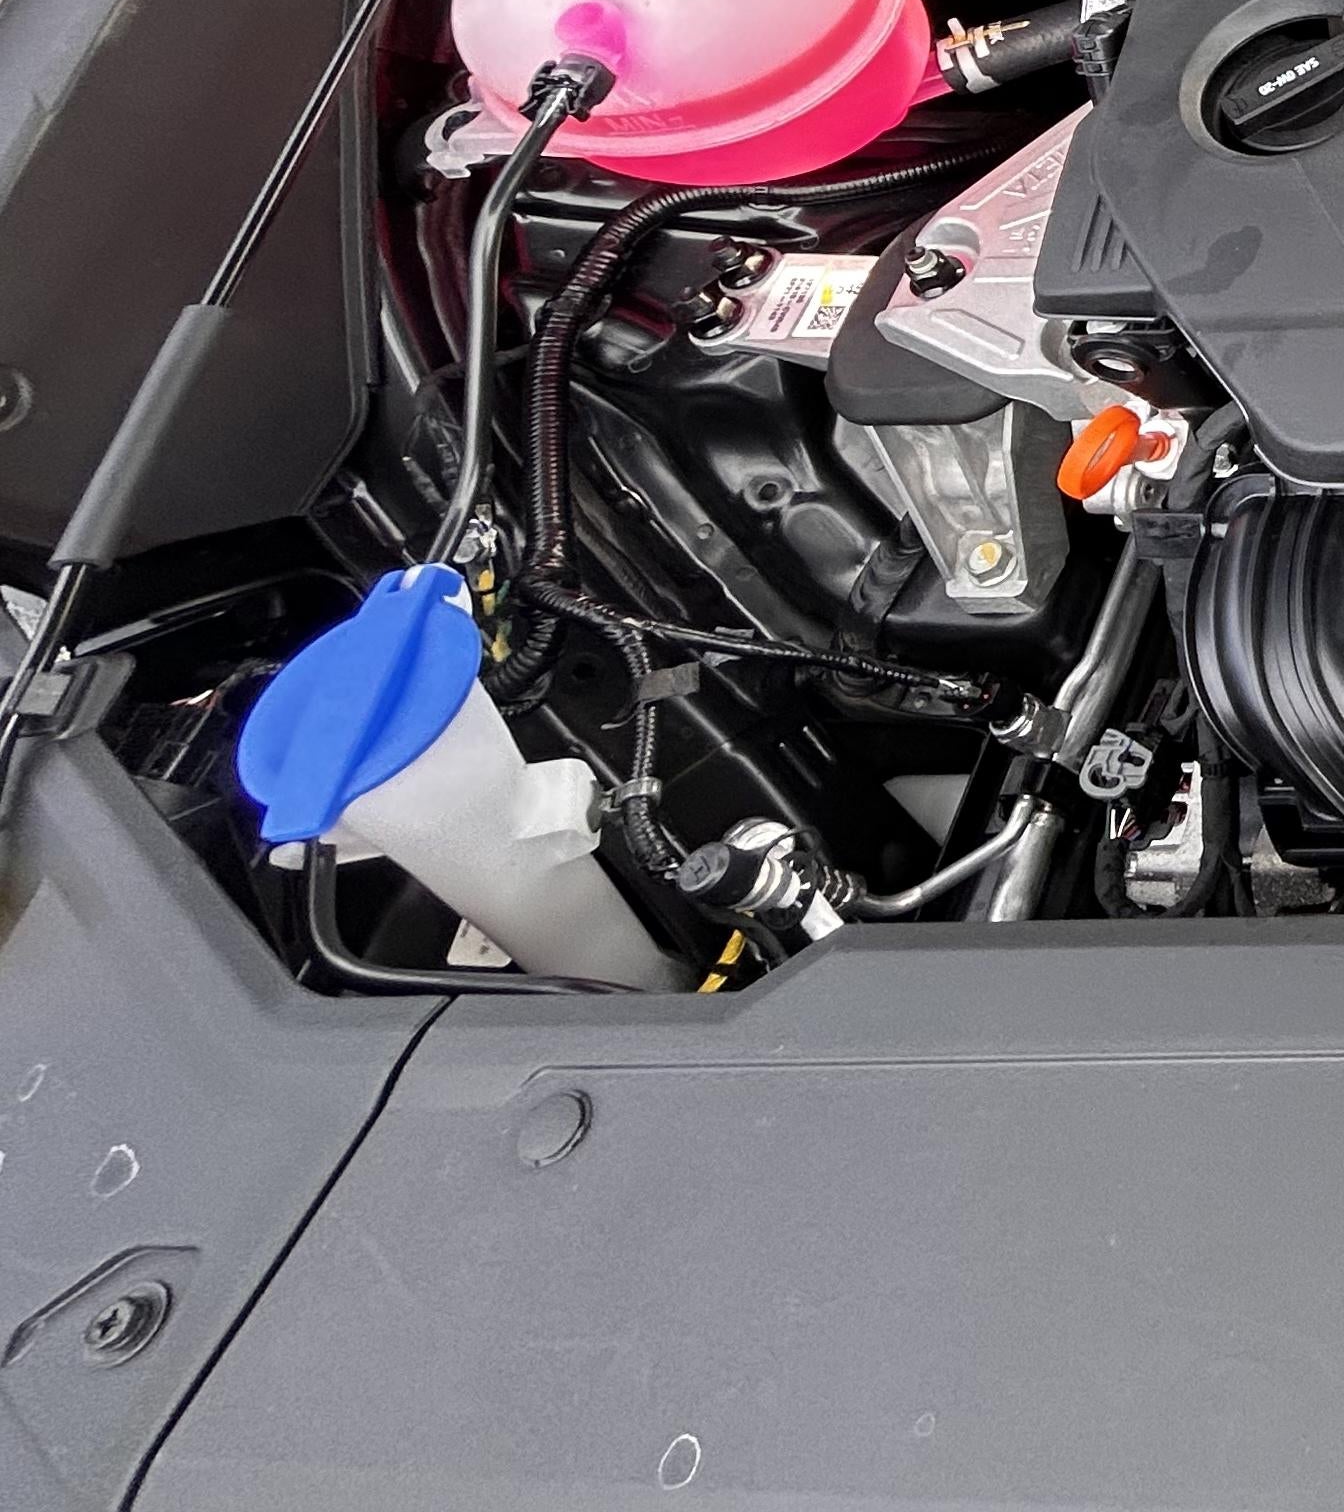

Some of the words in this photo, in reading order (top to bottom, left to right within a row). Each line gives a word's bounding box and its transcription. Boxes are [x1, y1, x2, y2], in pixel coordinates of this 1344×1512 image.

[1293, 56, 1320, 76] SAE
[1258, 69, 1297, 96] 0W-20
[603, 112, 668, 132] MIN
